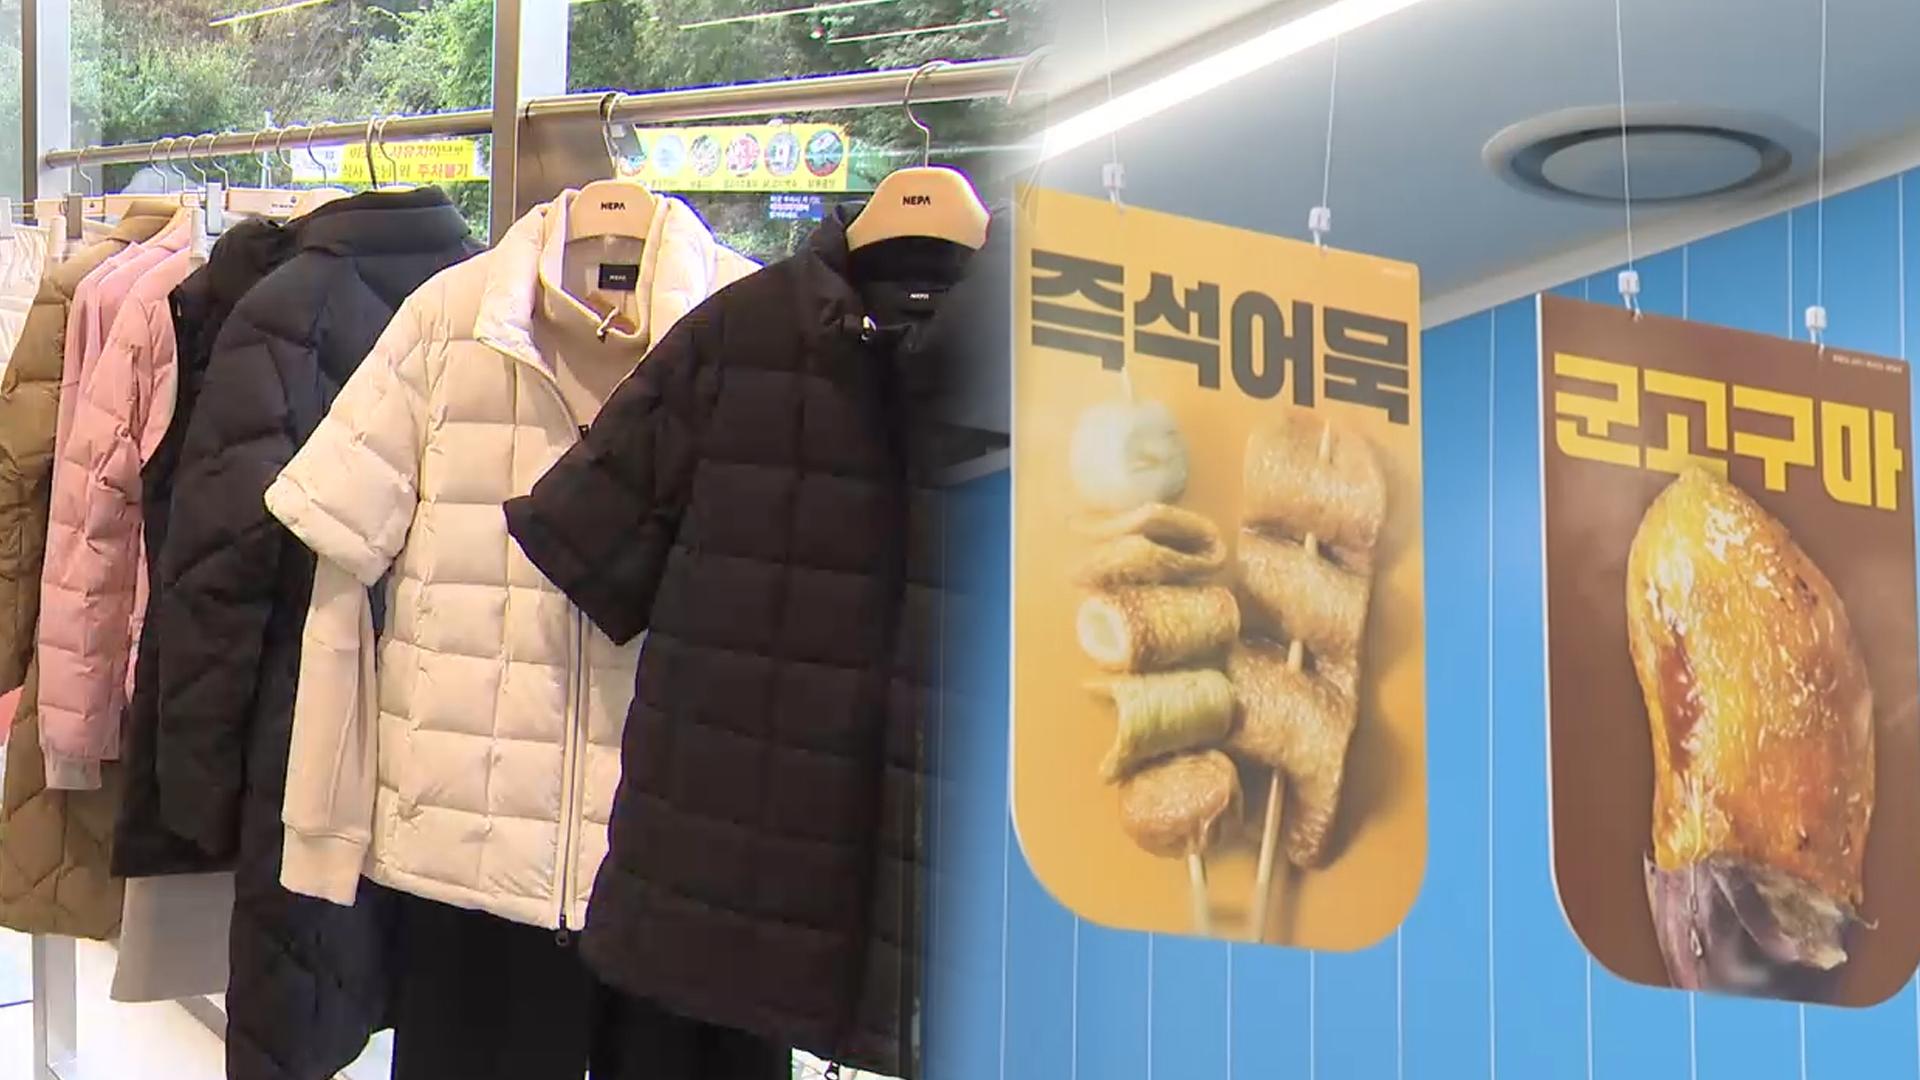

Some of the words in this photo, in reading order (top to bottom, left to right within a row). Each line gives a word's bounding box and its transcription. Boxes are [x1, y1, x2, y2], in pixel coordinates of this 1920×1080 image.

[600, 201, 626, 210] NEPA
[902, 195, 931, 205] NEPA
[1031, 248, 1410, 426] 즉석어묵
[1553, 352, 1903, 512] 군고구마
